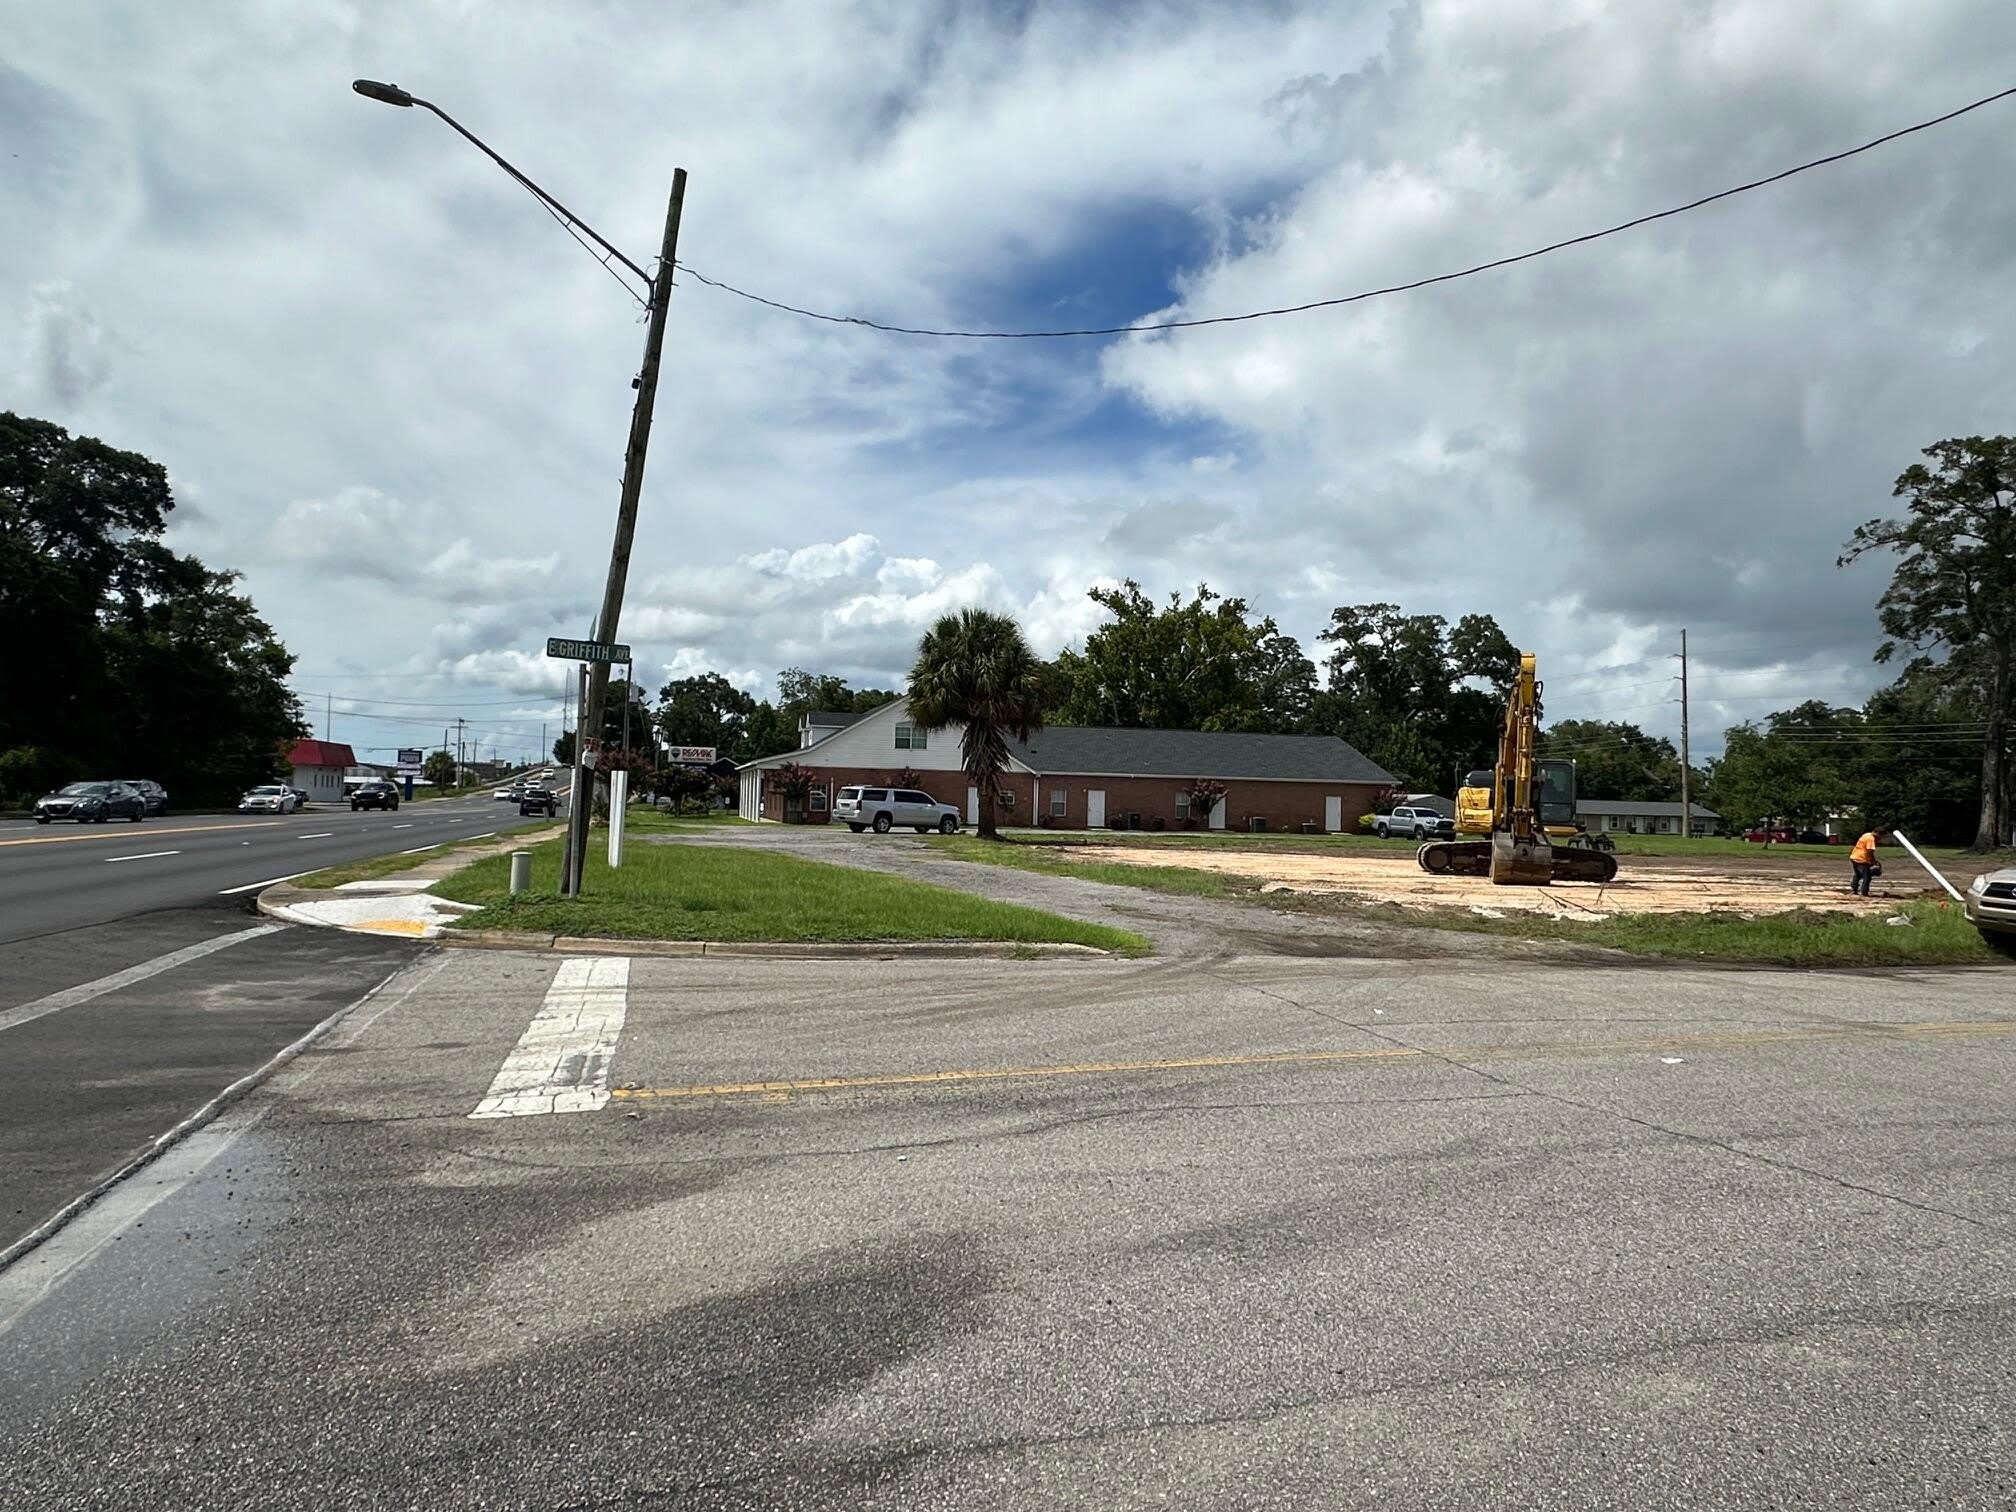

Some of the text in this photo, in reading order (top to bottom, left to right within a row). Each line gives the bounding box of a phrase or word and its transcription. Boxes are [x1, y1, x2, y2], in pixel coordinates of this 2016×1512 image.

[548, 640, 629, 660] E GRIFFITH AVE
